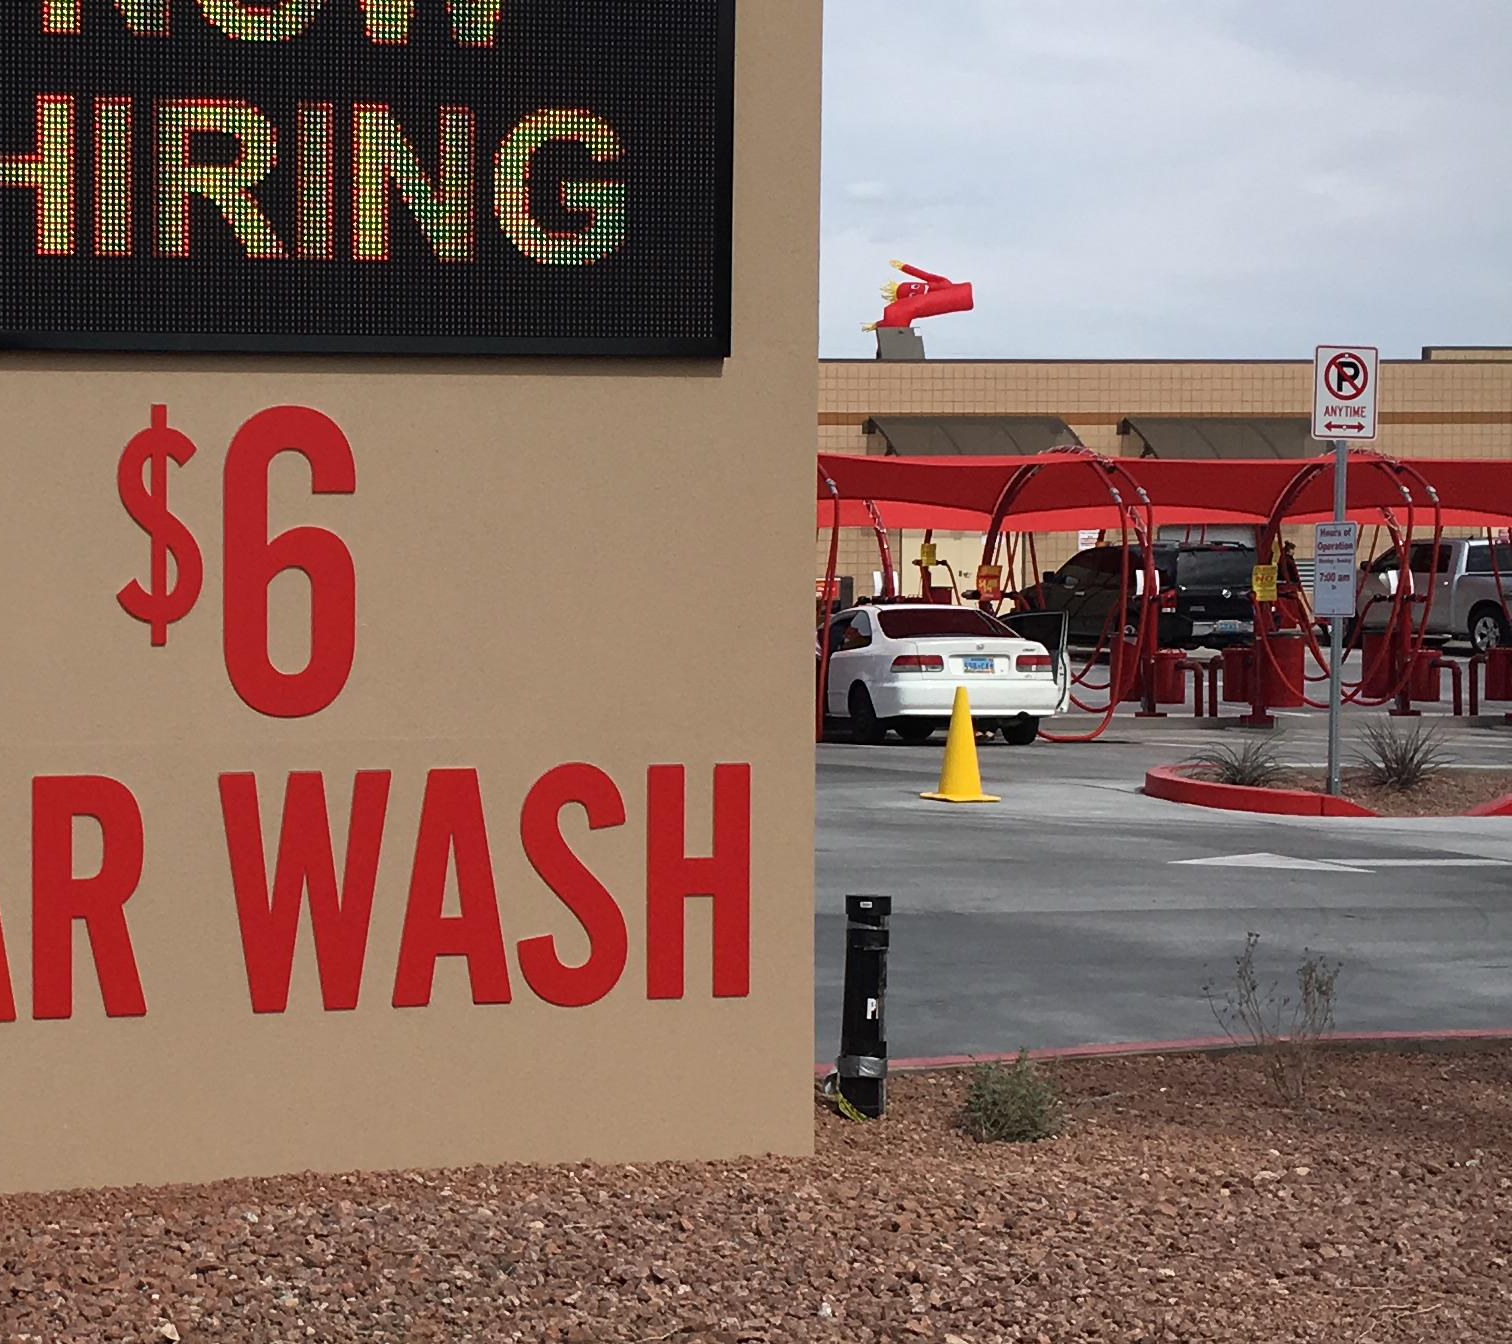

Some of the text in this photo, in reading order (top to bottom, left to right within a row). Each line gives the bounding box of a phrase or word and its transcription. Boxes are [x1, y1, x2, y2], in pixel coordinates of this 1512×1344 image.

[1324, 405, 1366, 418] ANYTIME
[115, 403, 357, 719] $6
[217, 761, 751, 1014] WASH
